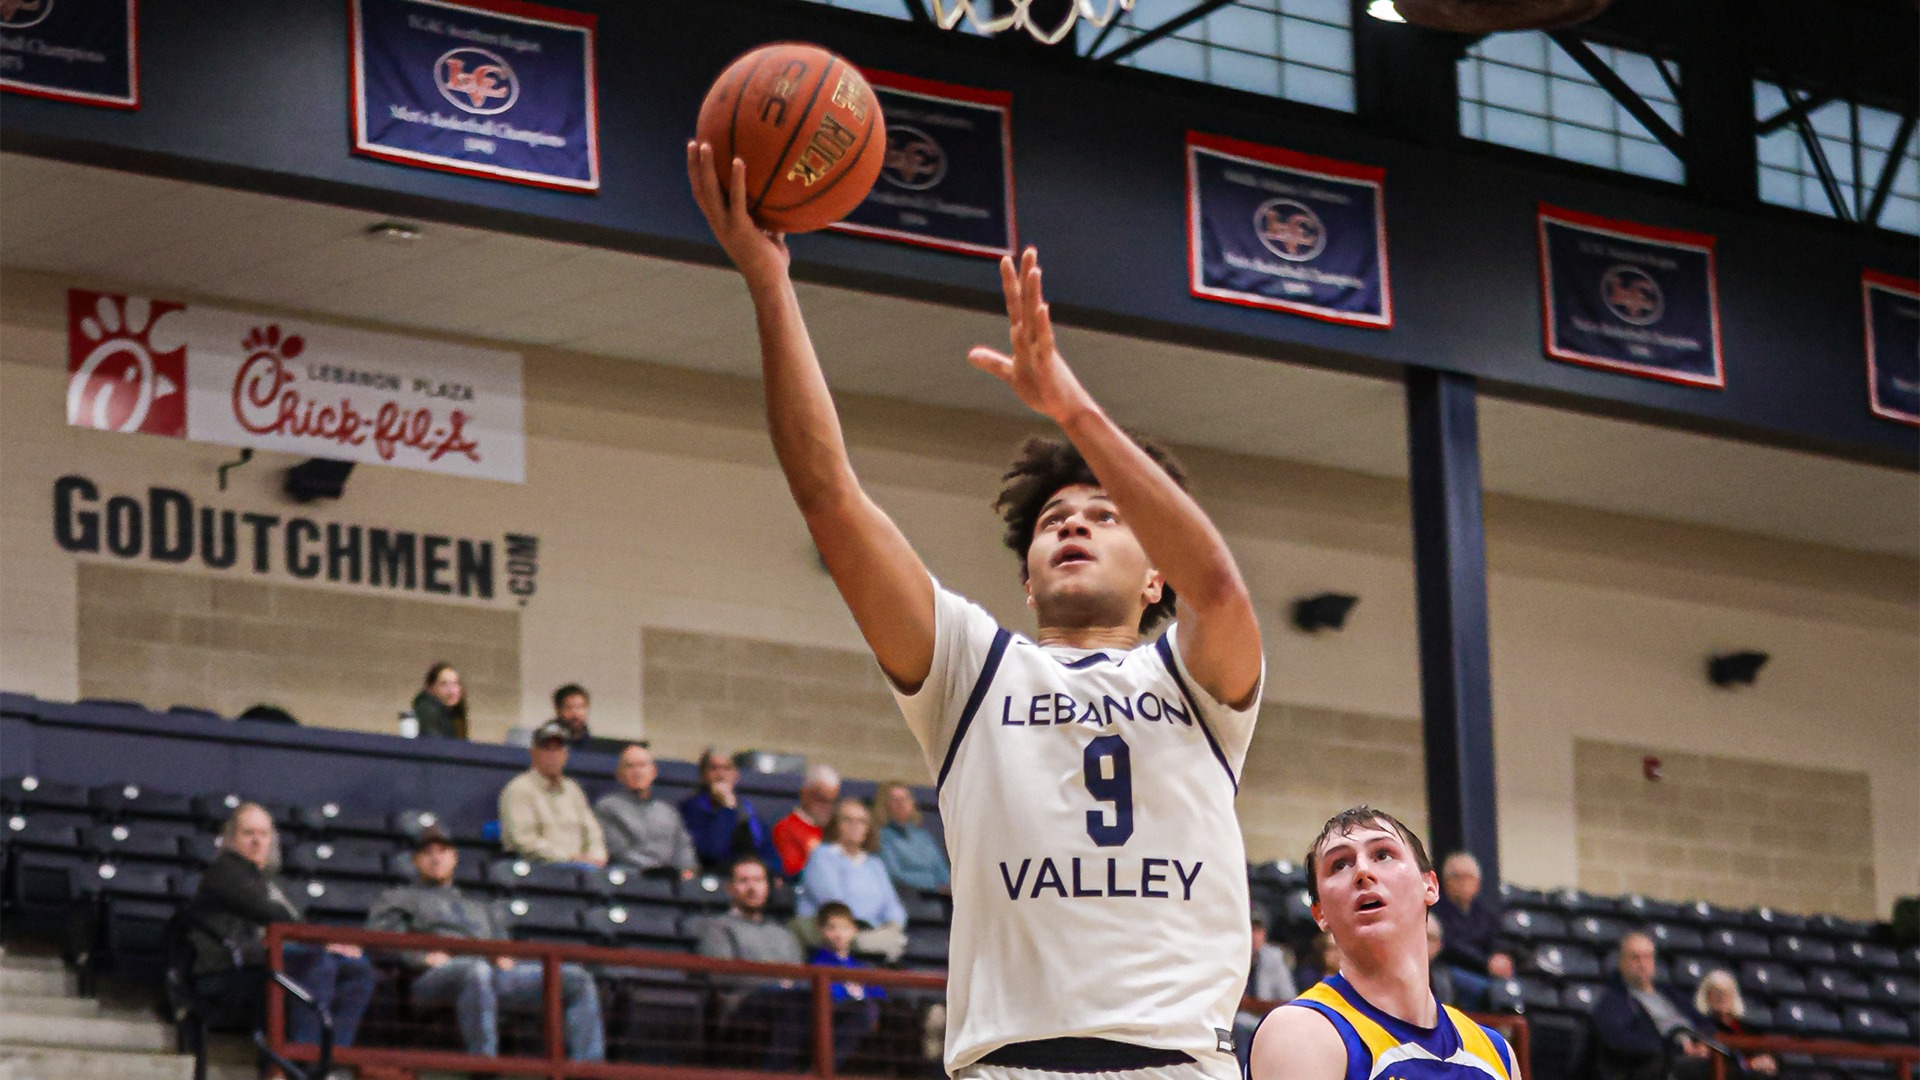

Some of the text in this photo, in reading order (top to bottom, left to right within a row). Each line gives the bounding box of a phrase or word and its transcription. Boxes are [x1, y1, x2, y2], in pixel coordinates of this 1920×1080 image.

[787, 111, 857, 187] ROCK
[231, 350, 482, 462] Chick-fil-A
[306, 363, 474, 402] LEBANON PLAZA
[1001, 692, 1193, 727] LEBANON
[1083, 733, 1135, 848] 9
[999, 857, 1204, 901] VALLEY
